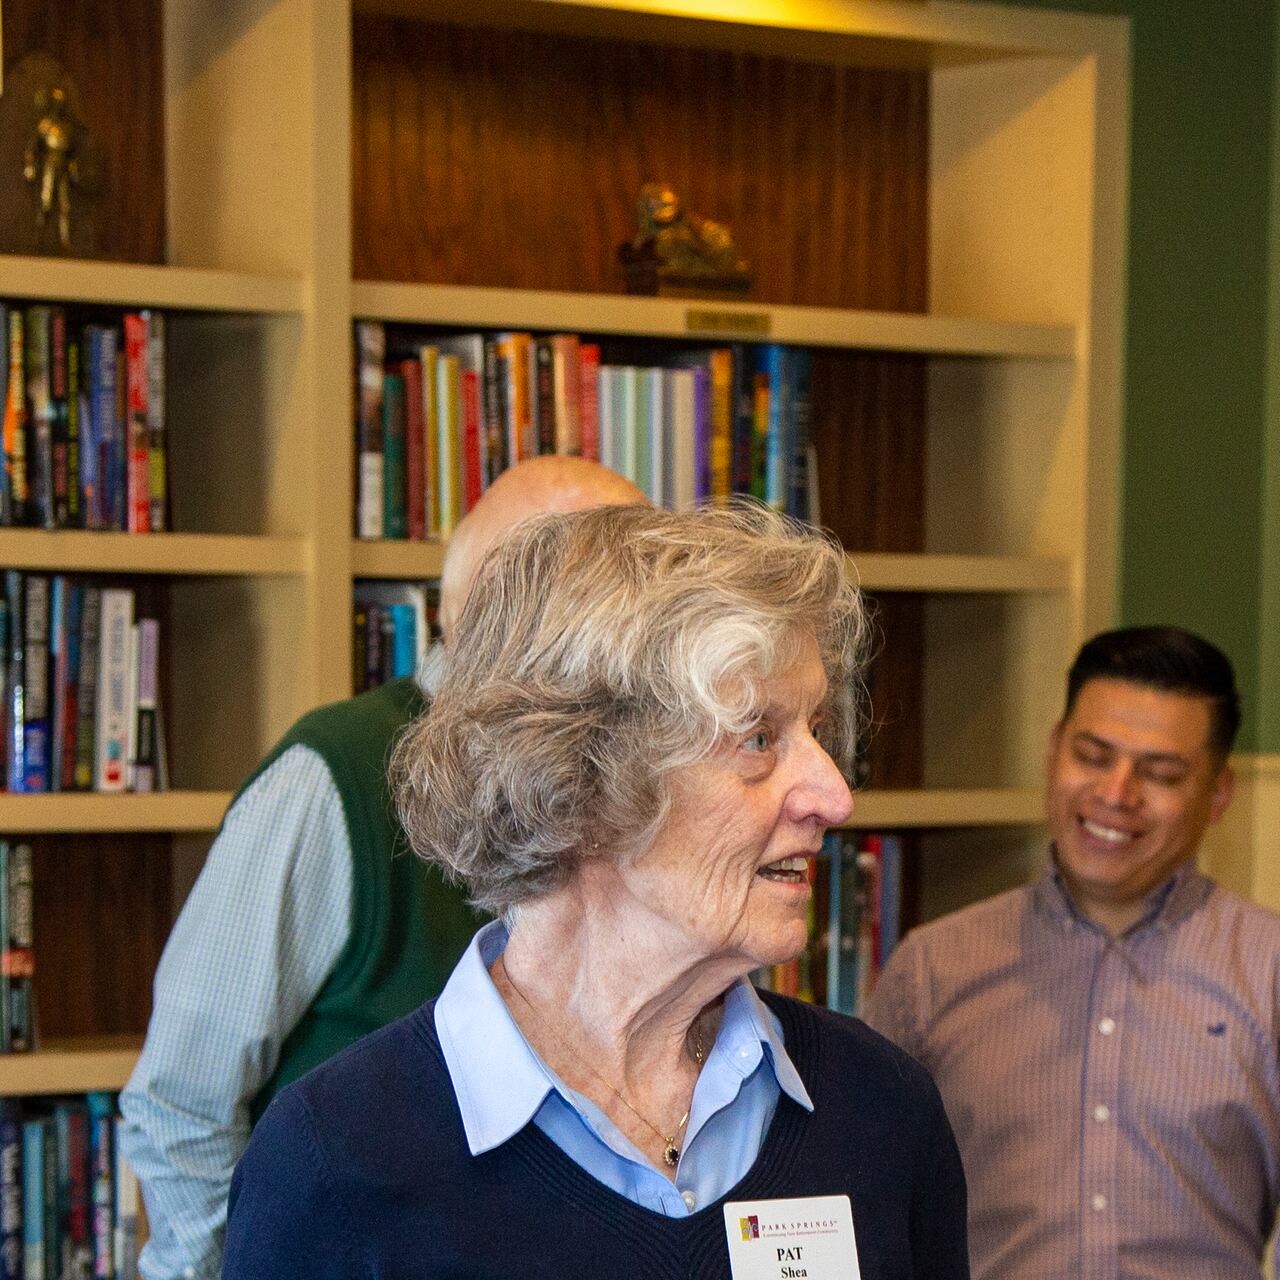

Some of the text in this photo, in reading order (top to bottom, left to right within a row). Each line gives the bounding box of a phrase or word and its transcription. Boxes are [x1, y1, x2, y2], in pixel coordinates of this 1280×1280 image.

[761, 1223, 787, 1231] PARK
[776, 1246, 803, 1262] PAT
[781, 1267, 808, 1279] Shea
